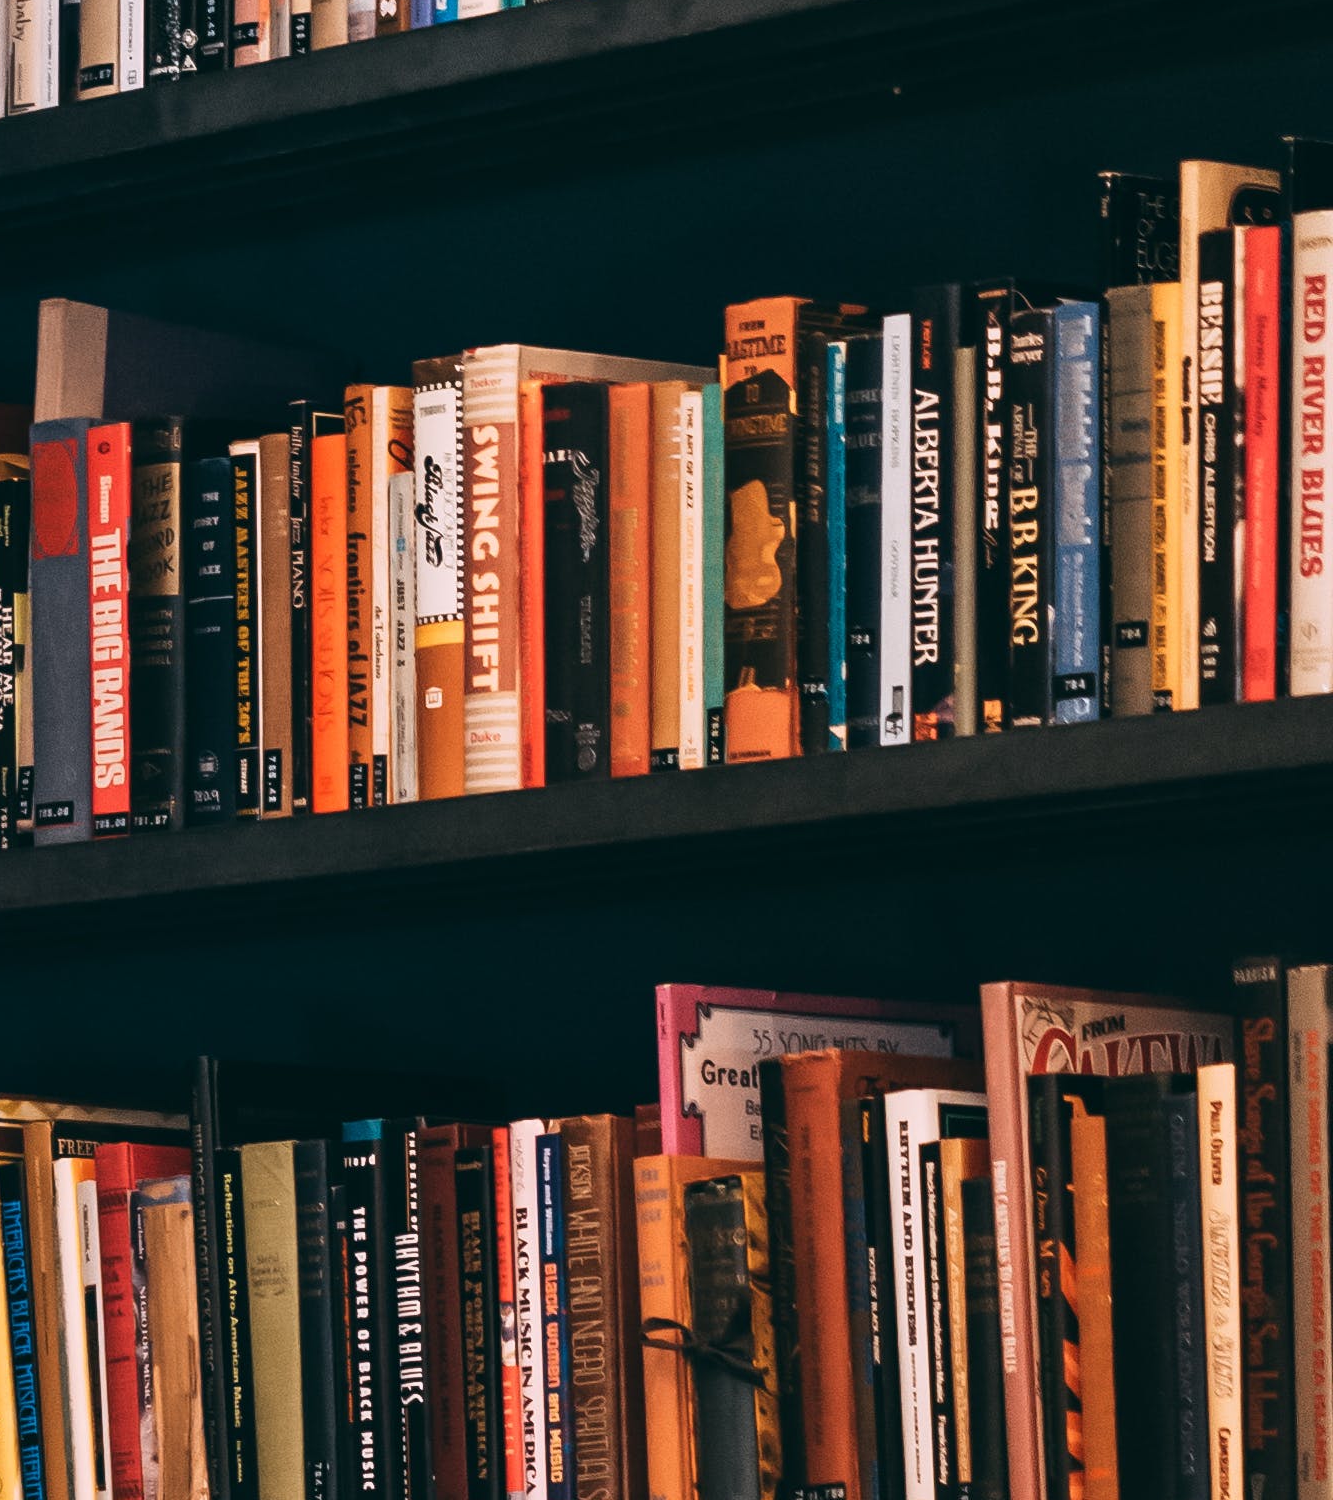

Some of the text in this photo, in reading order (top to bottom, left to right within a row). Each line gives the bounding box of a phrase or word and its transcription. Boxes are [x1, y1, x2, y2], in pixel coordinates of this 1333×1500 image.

[1200, 281, 1223, 405] BESSIE
[1300, 275, 1325, 576] RED RIVER BLUES
[93, 528, 123, 788] THE BIG BANDS
[472, 425, 498, 692] SWING SHIFT
[914, 389, 938, 666] ALBERTA HUNTER
[353, 1207, 375, 1490] THE POWER OF BLACK MUSIC
